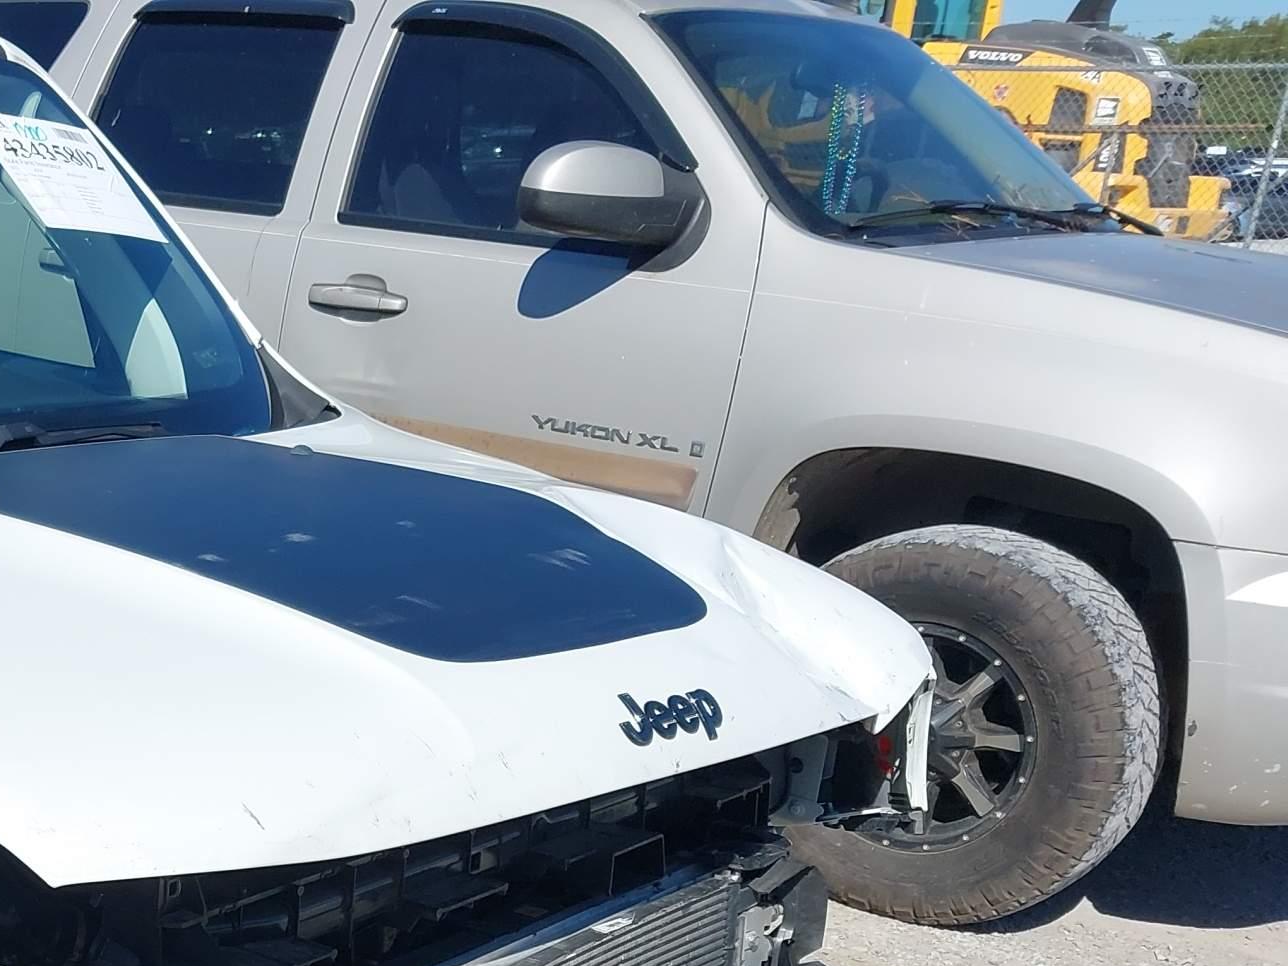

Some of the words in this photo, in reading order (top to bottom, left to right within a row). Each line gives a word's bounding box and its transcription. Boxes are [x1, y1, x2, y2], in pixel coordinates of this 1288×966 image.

[968, 49, 1024, 63] VOLVO
[3, 137, 105, 171] 43435802
[531, 414, 632, 445] YUKON
[635, 432, 679, 453] XL
[617, 688, 723, 747] Jeep
